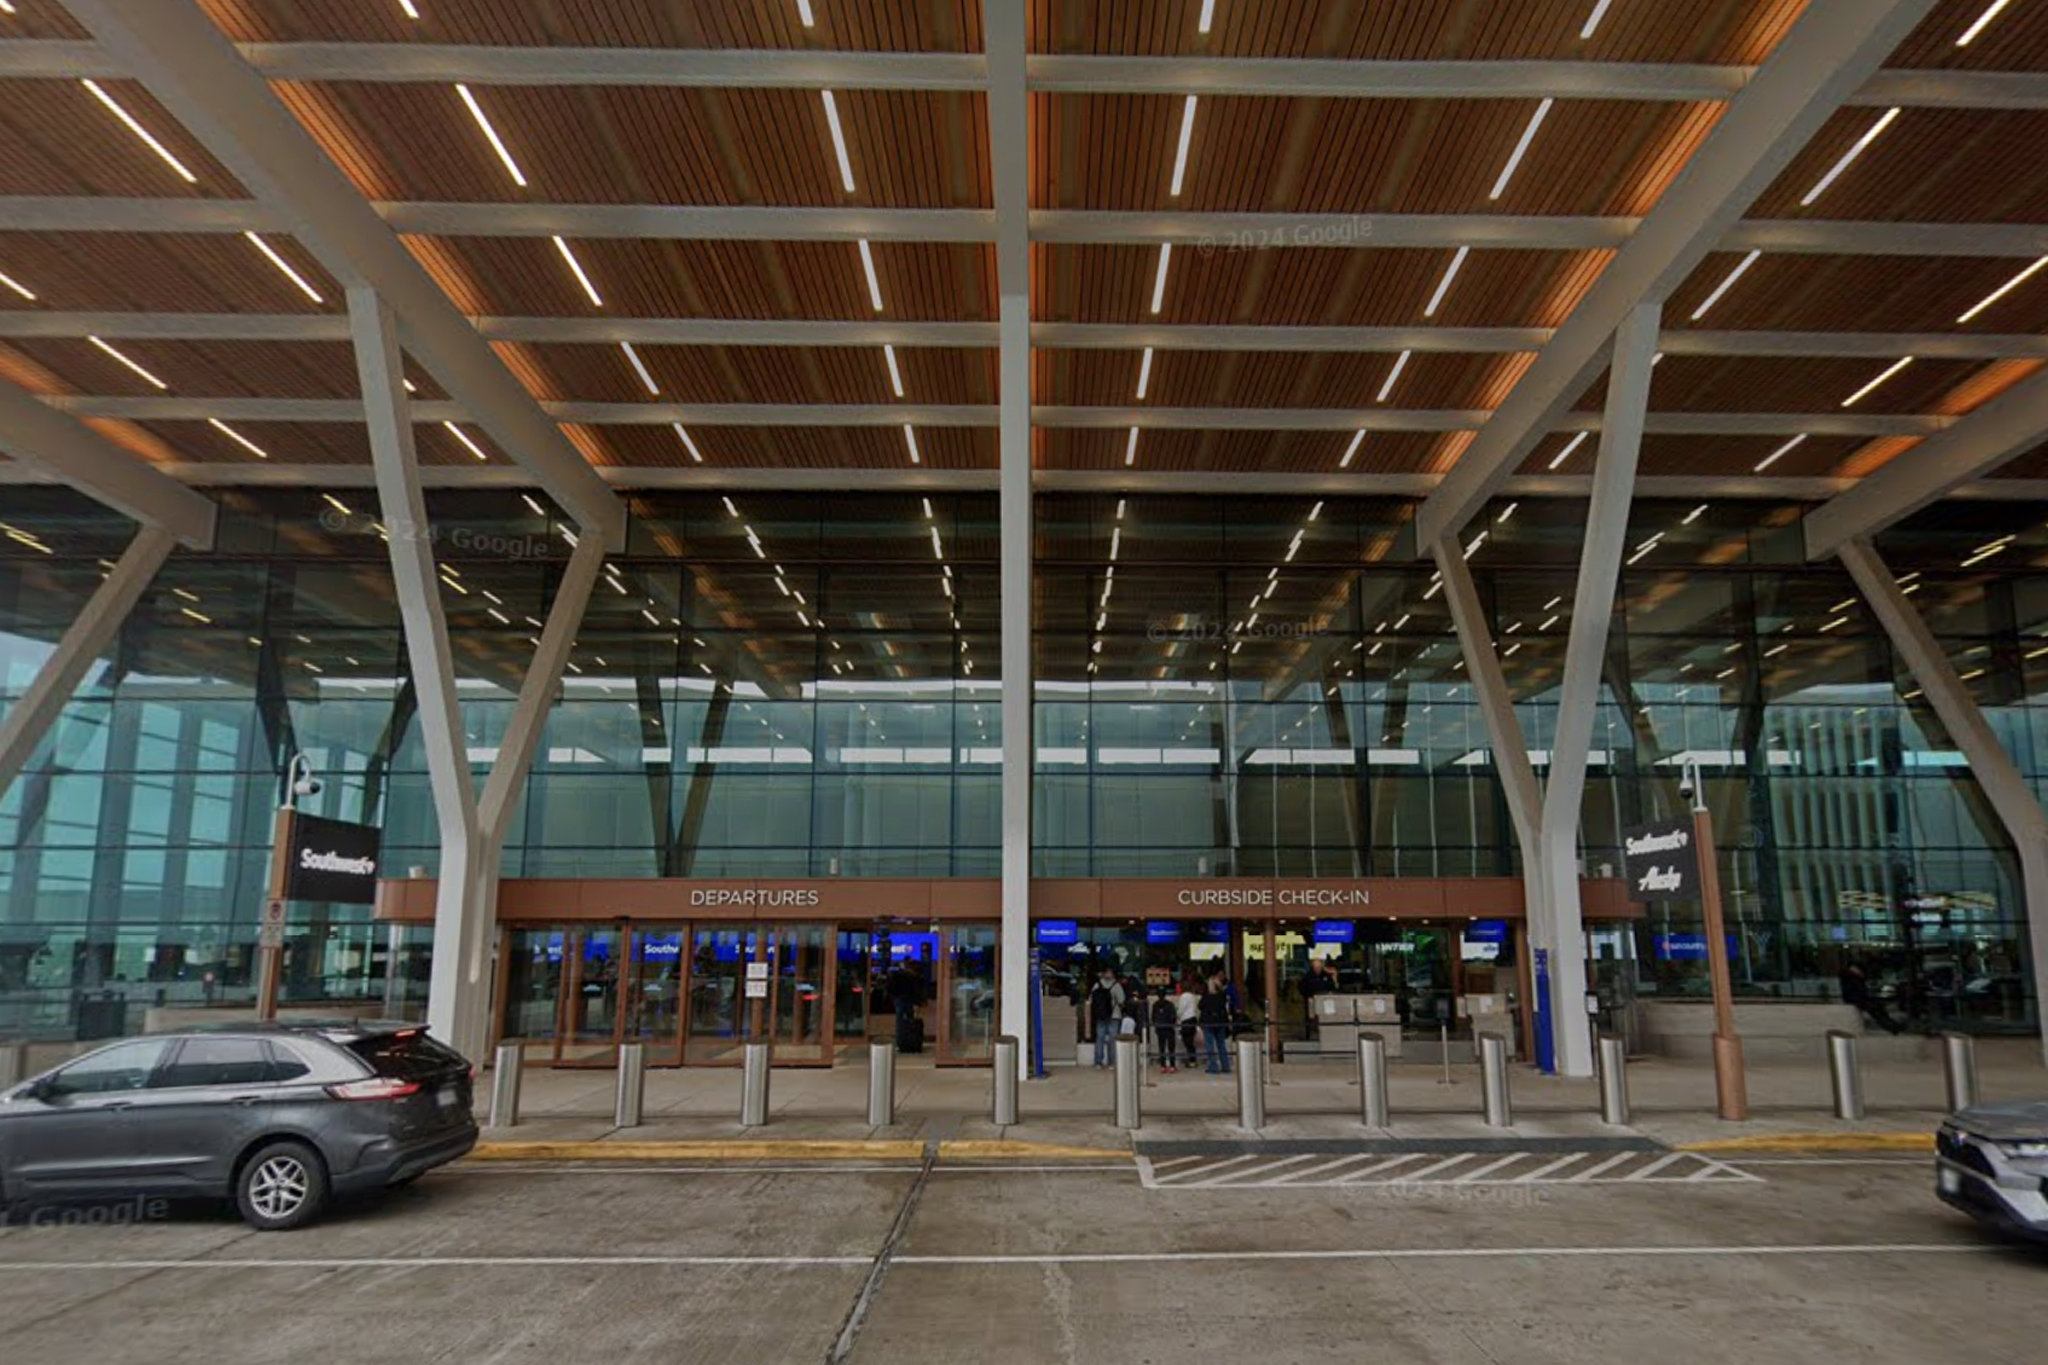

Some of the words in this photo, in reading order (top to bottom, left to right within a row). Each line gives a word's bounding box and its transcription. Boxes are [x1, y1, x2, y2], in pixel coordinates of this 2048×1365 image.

[300, 848, 368, 874] Southwest
[690, 889, 820, 906] DEPARTURES
[1177, 889, 1273, 905] CURBSIDE
[1278, 889, 1370, 905] CHECK-IN
